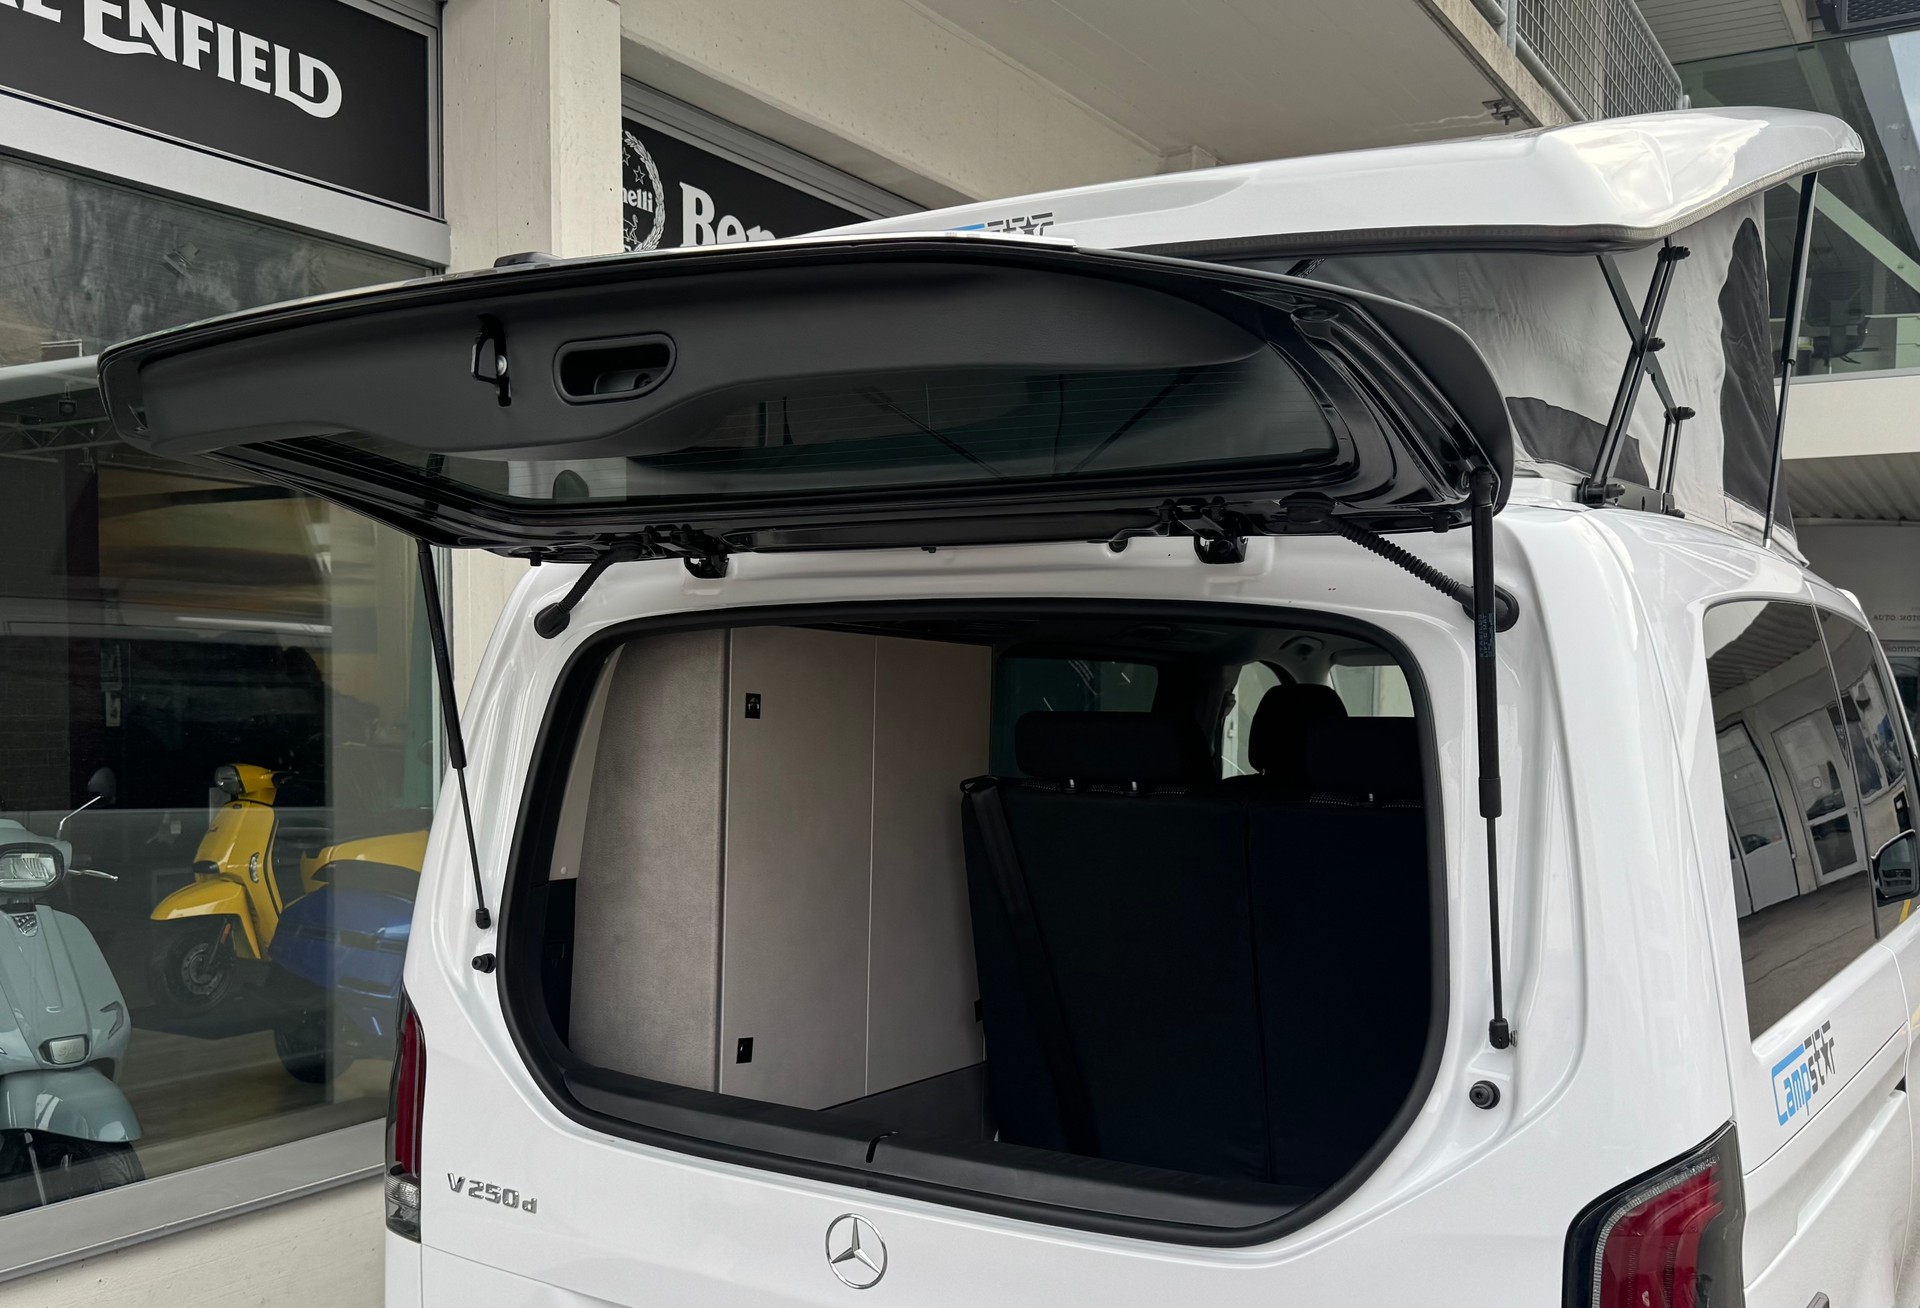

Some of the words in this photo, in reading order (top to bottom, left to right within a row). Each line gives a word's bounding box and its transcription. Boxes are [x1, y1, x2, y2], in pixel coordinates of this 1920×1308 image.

[83, 0, 342, 118] ENFIELD
[447, 1172, 466, 1194] V
[468, 1180, 520, 1210] 250
[521, 1197, 538, 1214] d
